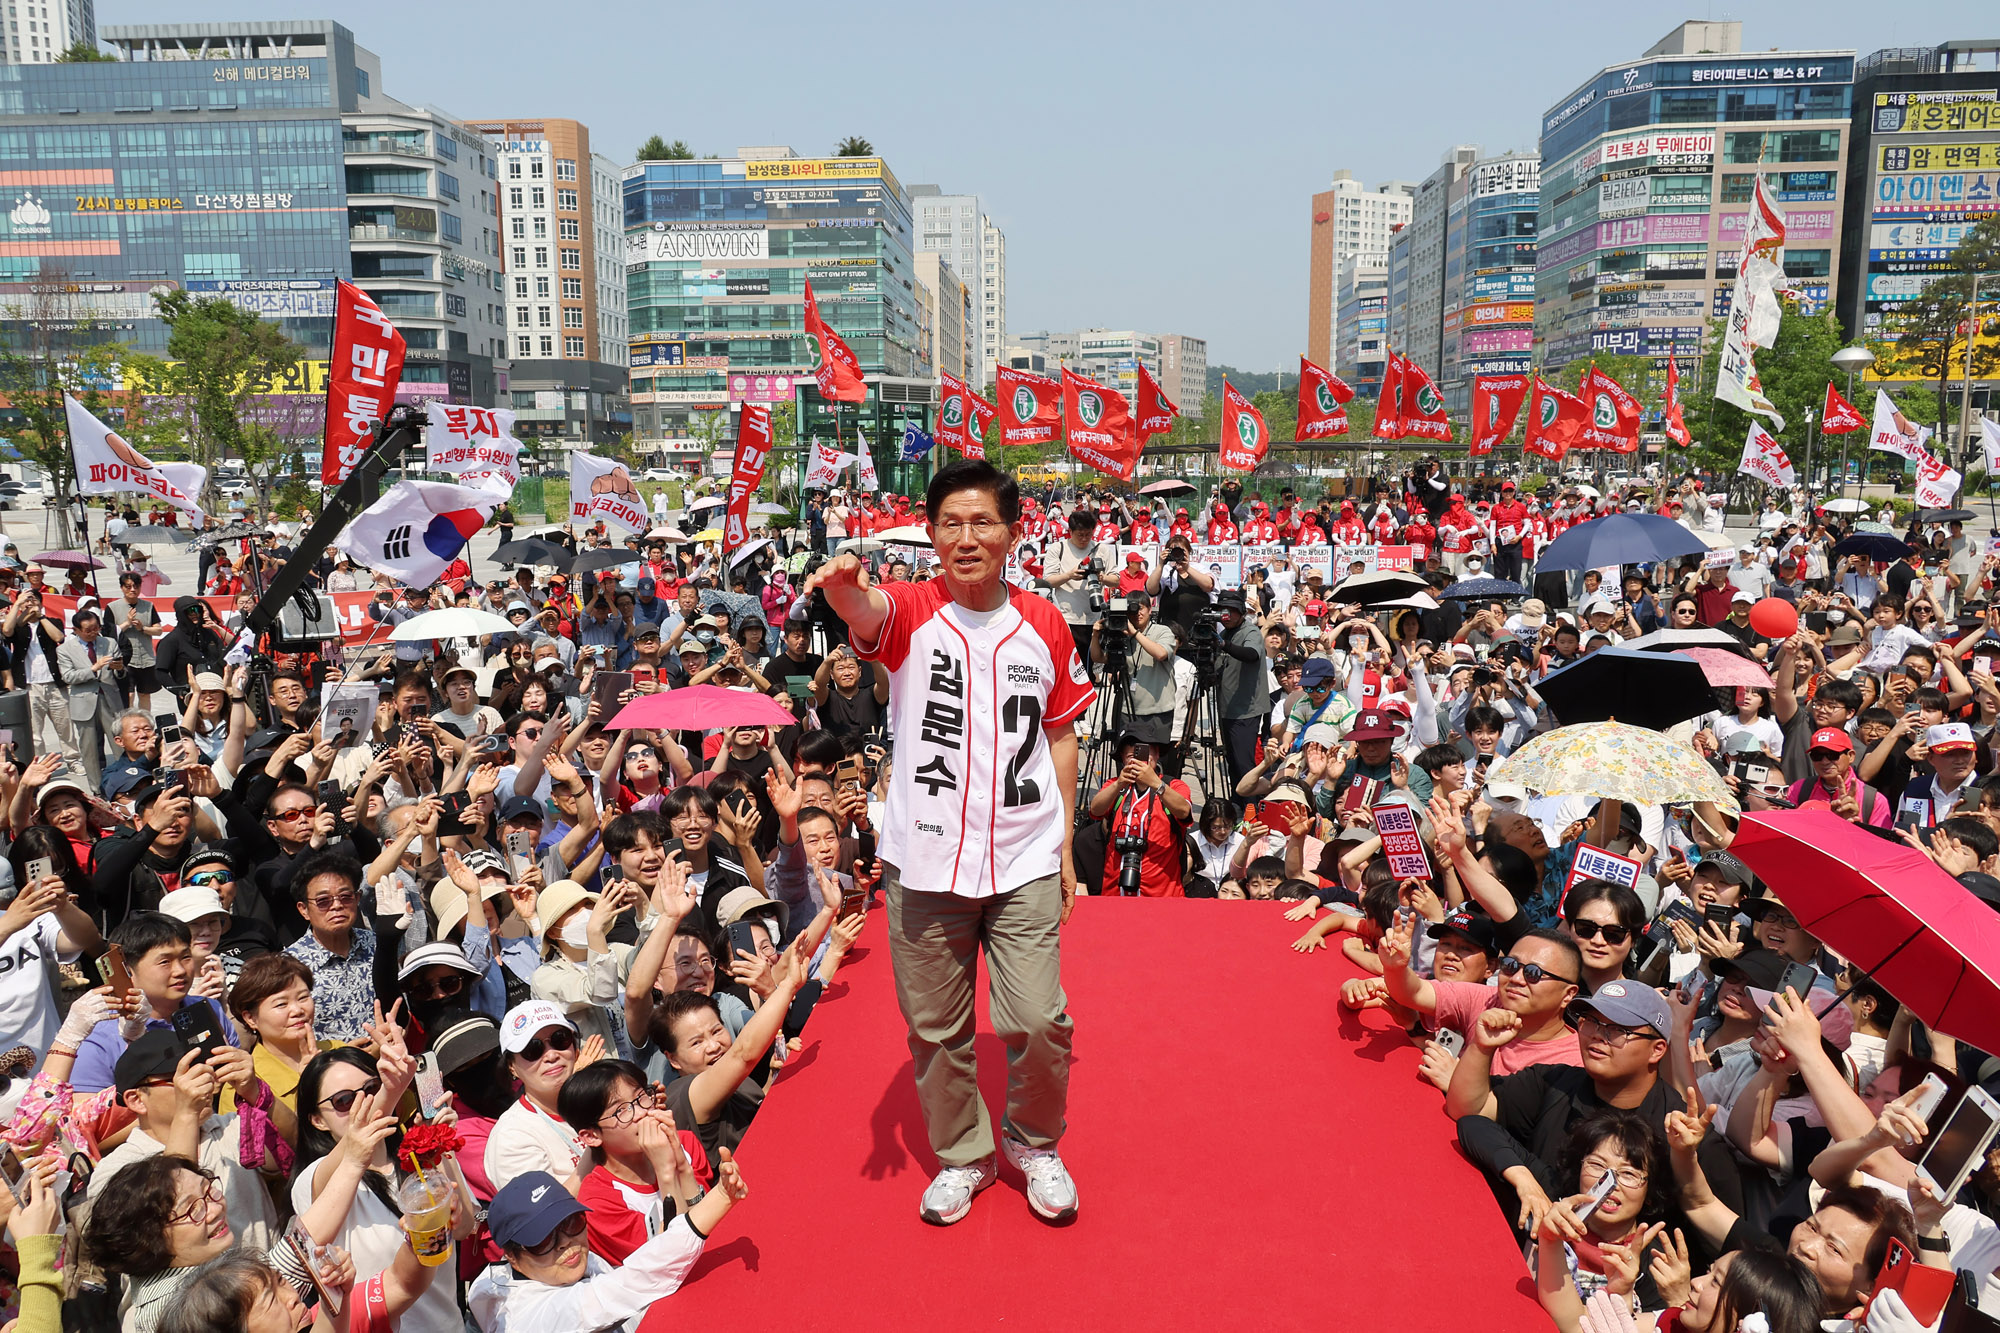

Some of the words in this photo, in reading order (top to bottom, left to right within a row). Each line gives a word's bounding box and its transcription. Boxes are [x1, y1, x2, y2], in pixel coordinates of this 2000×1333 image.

[213, 67, 240, 82] 신해
[243, 65, 310, 81] 메디컬타워
[1692, 67, 1769, 82] 원티어피트니스
[1773, 67, 1794, 80] 헬스
[1796, 66, 1806, 79] &
[1807, 66, 1824, 78] PT
[1625, 81, 1653, 93] FITNESS
[1888, 94, 1954, 105] 서울온케어의원
[1954, 93, 1995, 103] 1577-7998
[1911, 109, 1920, 130] 서울
[1607, 138, 1649, 158] 킥복싱
[1656, 136, 1712, 152] 무에타이
[1656, 154, 1709, 165] 555-1282
[1887, 148, 1907, 159] 특화
[748, 163, 822, 177] 남성전용사우나
[1886, 159, 1906, 169] 진료
[1479, 163, 1514, 194] 미술학원
[1791, 173, 1808, 181] 다산
[865, 190, 879, 198] 24시
[1602, 180, 1646, 201] 필라테스
[1879, 174, 2000, 202] 아이엔소
[76, 195, 110, 211] 24시
[113, 197, 184, 210] 힐링플레이스
[195, 193, 293, 210] 다산킹찜질방
[1651, 195, 1662, 203] PT
[1669, 194, 1708, 203] 기구필라테스
[670, 223, 700, 231] ANIWIN
[1656, 217, 1671, 227] 오전
[1672, 216, 1701, 226] 8시진료
[12, 227, 51, 235] DASANKING
[1601, 216, 1647, 245] 내과
[1915, 227, 1924, 245] 다산
[657, 232, 760, 257] ANIWIN
[1880, 251, 1906, 260] 중이염
[1606, 294, 1637, 303] 2:17:59
[1475, 307, 1505, 321] 여의사
[1597, 310, 1612, 321] 치과
[1592, 330, 1640, 354] 피부과
[1471, 362, 1505, 373] 비뇨의학과
[444, 408, 500, 440] 복지
[432, 447, 513, 467] 국민행복위원회
[1033, 521, 1042, 533] 2
[1226, 527, 1234, 538] 2
[1264, 526, 1273, 538] 2
[1351, 525, 1360, 539] 2
[1386, 525, 1394, 538] 2
[1536, 521, 1544, 533] 2
[1103, 528, 1113, 540] 2
[1185, 530, 1193, 542] 2
[1312, 532, 1321, 541] 2
[1007, 664, 1040, 675] PEOPLE
[1007, 673, 1040, 684] POWER
[1013, 682, 1034, 690] PARTY
[914, 648, 964, 797] 김문수
[1002, 694, 1042, 808] 2
[1377, 811, 1412, 831] 대통령은
[916, 822, 943, 835] 국민의힘
[1383, 833, 1419, 853] 정정당당
[196, 852, 211, 861] YOUR
[1391, 857, 1399, 873] 2
[1398, 856, 1425, 874] 김문수
[1578, 852, 1633, 887] 대통령은
[1453, 916, 1469, 924] THE
[533, 1007, 553, 1015] AGAIN
[537, 1012, 558, 1022] KOREA
[532, 1184, 545, 1196] NIKE
